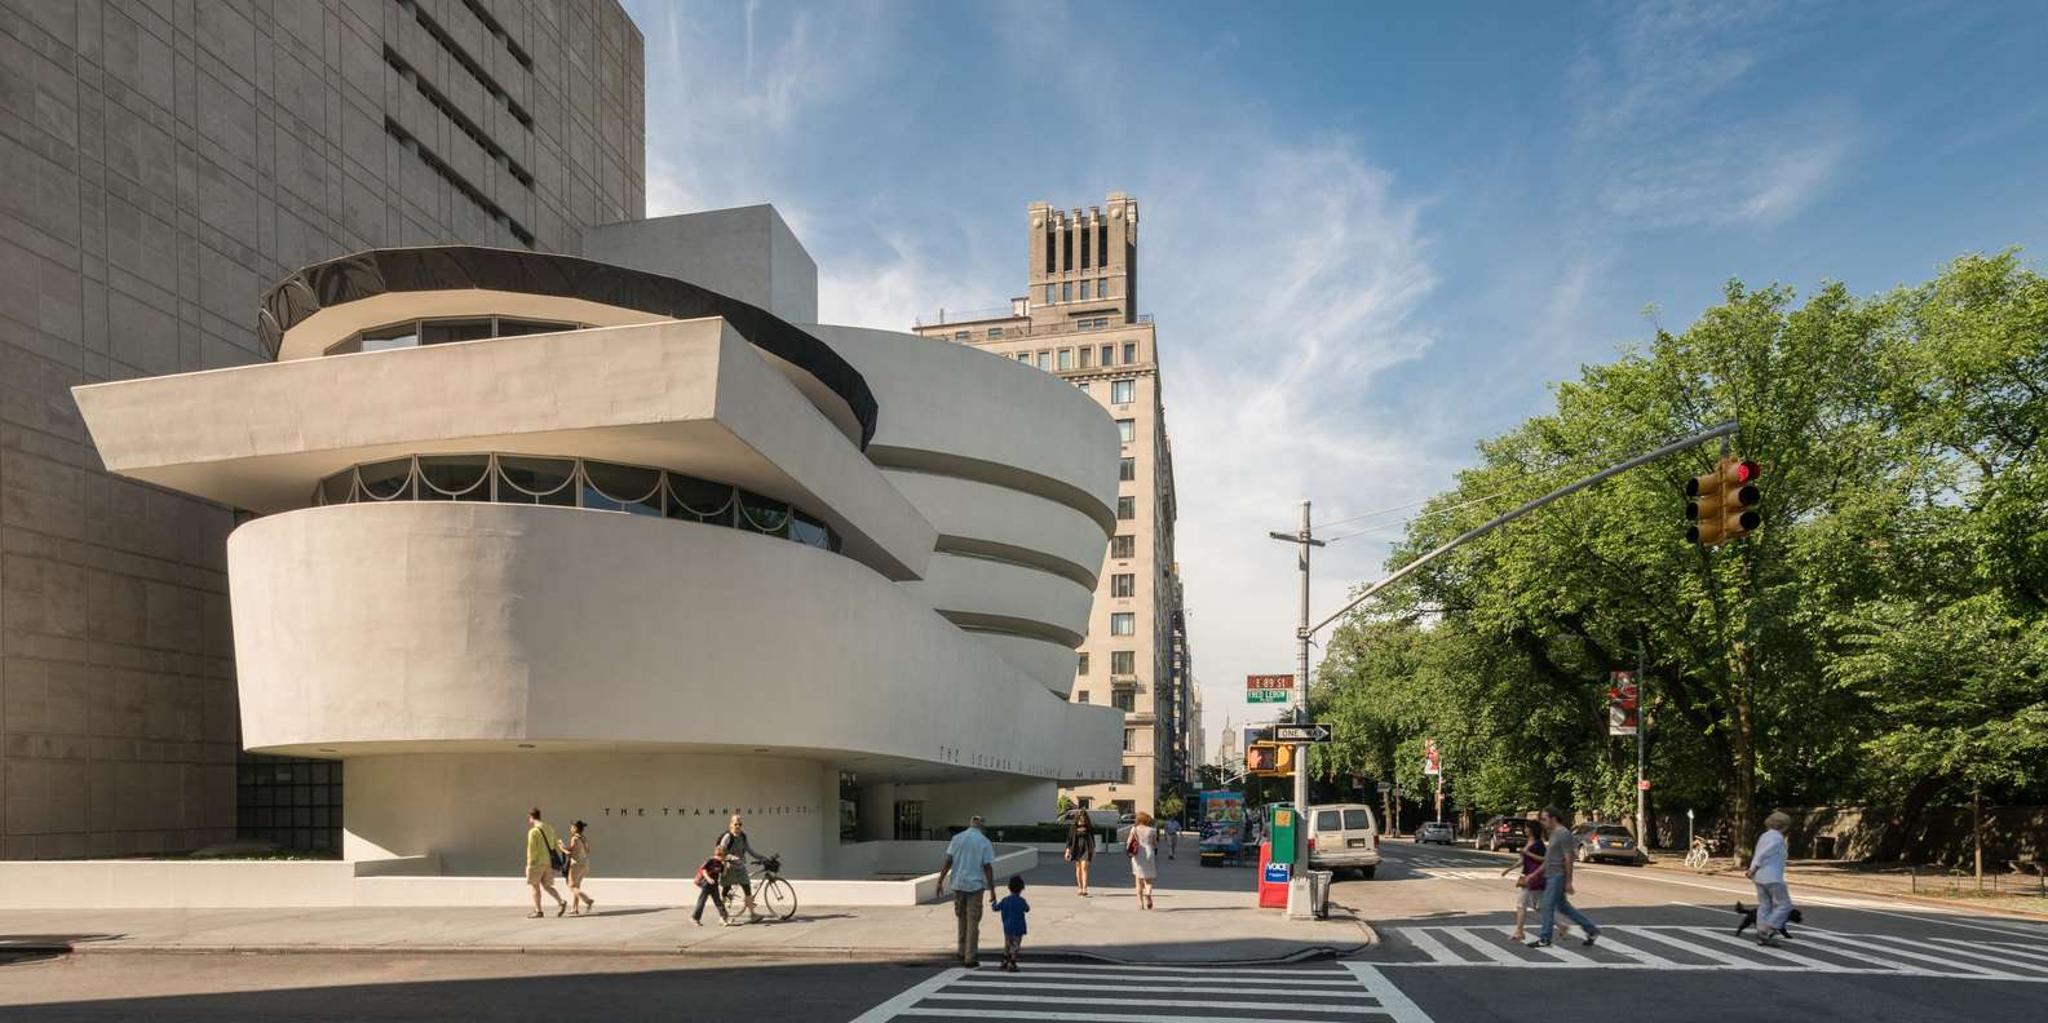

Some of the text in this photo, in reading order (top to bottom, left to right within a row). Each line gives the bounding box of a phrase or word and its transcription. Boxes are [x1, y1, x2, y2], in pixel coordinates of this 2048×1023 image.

[1263, 677, 1275, 688] 89
[1282, 729, 1323, 737] ONE WAY
[604, 808, 645, 817] THE
[1266, 862, 1288, 871] VOICE
